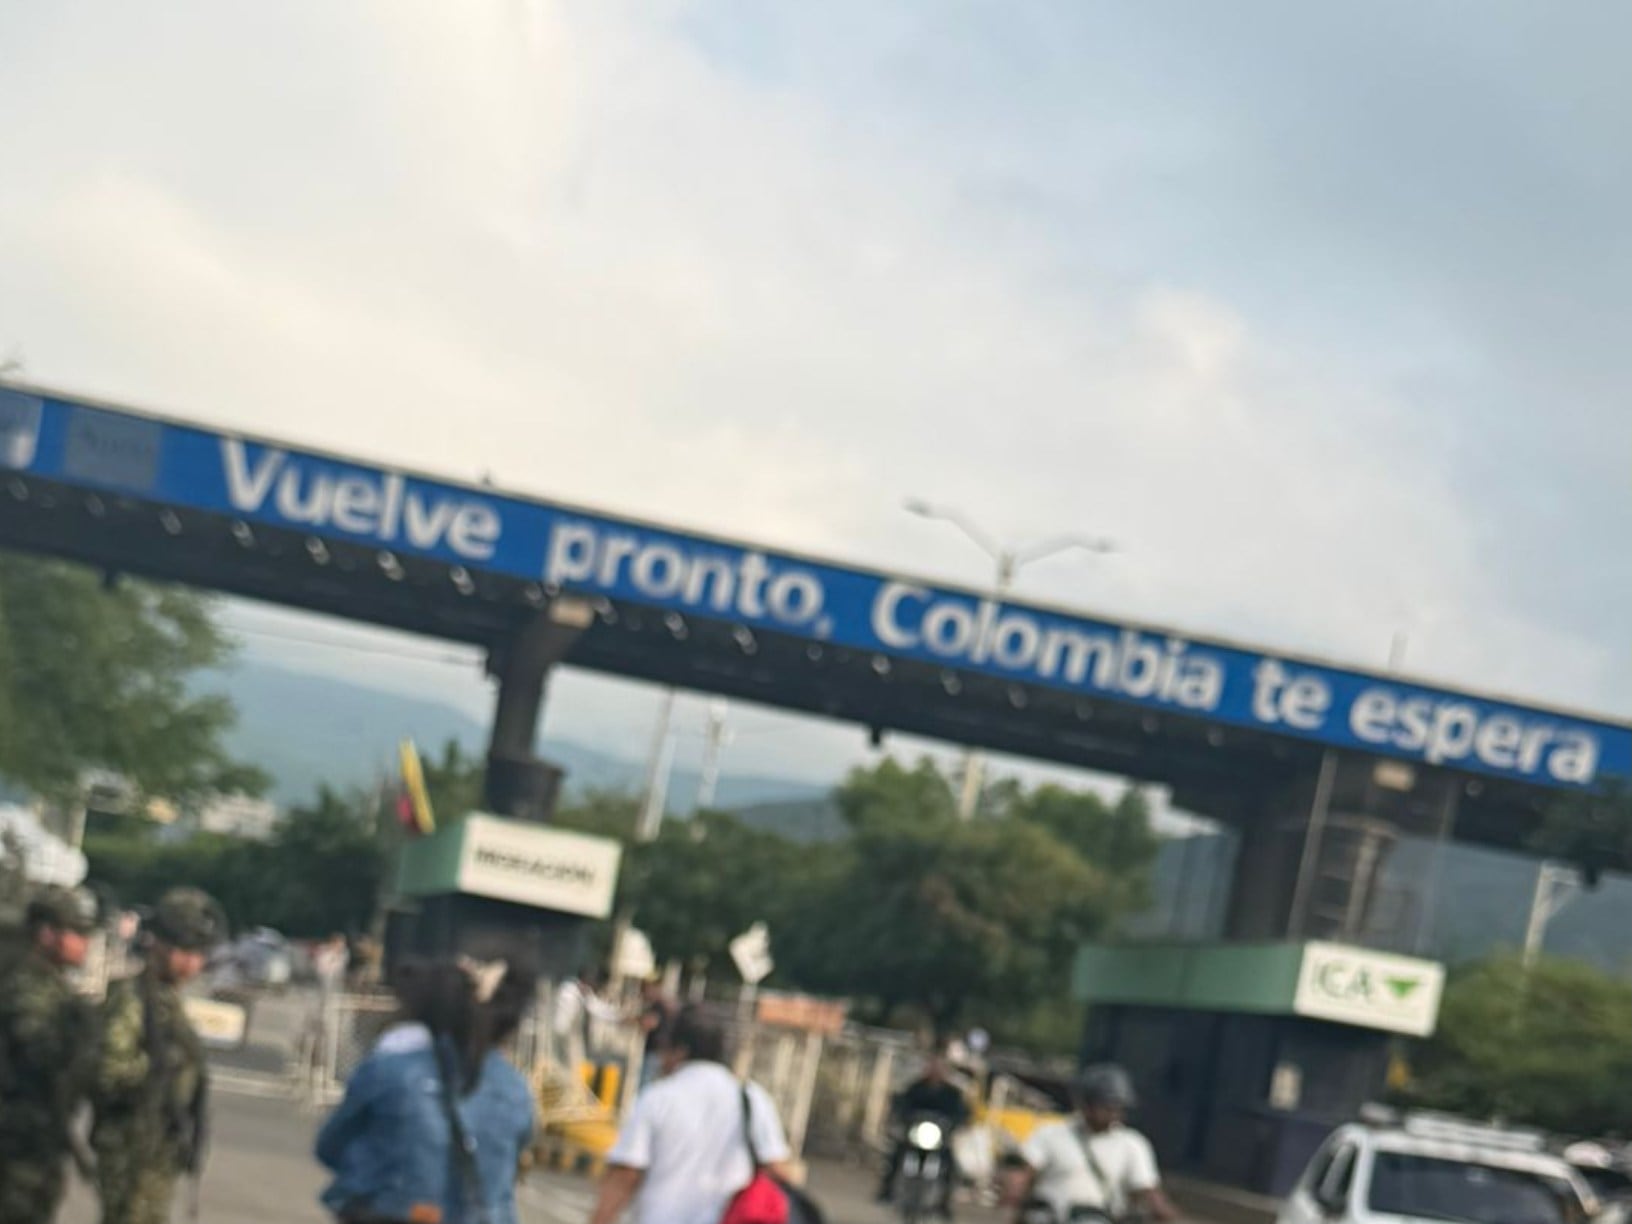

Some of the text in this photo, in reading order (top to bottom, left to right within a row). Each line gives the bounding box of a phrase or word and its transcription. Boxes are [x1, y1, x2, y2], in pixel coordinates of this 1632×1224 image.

[220, 438, 501, 560] Vuelve
[871, 583, 1225, 712] Colombia
[1250, 660, 1333, 730] te
[1349, 701, 1598, 784] espera
